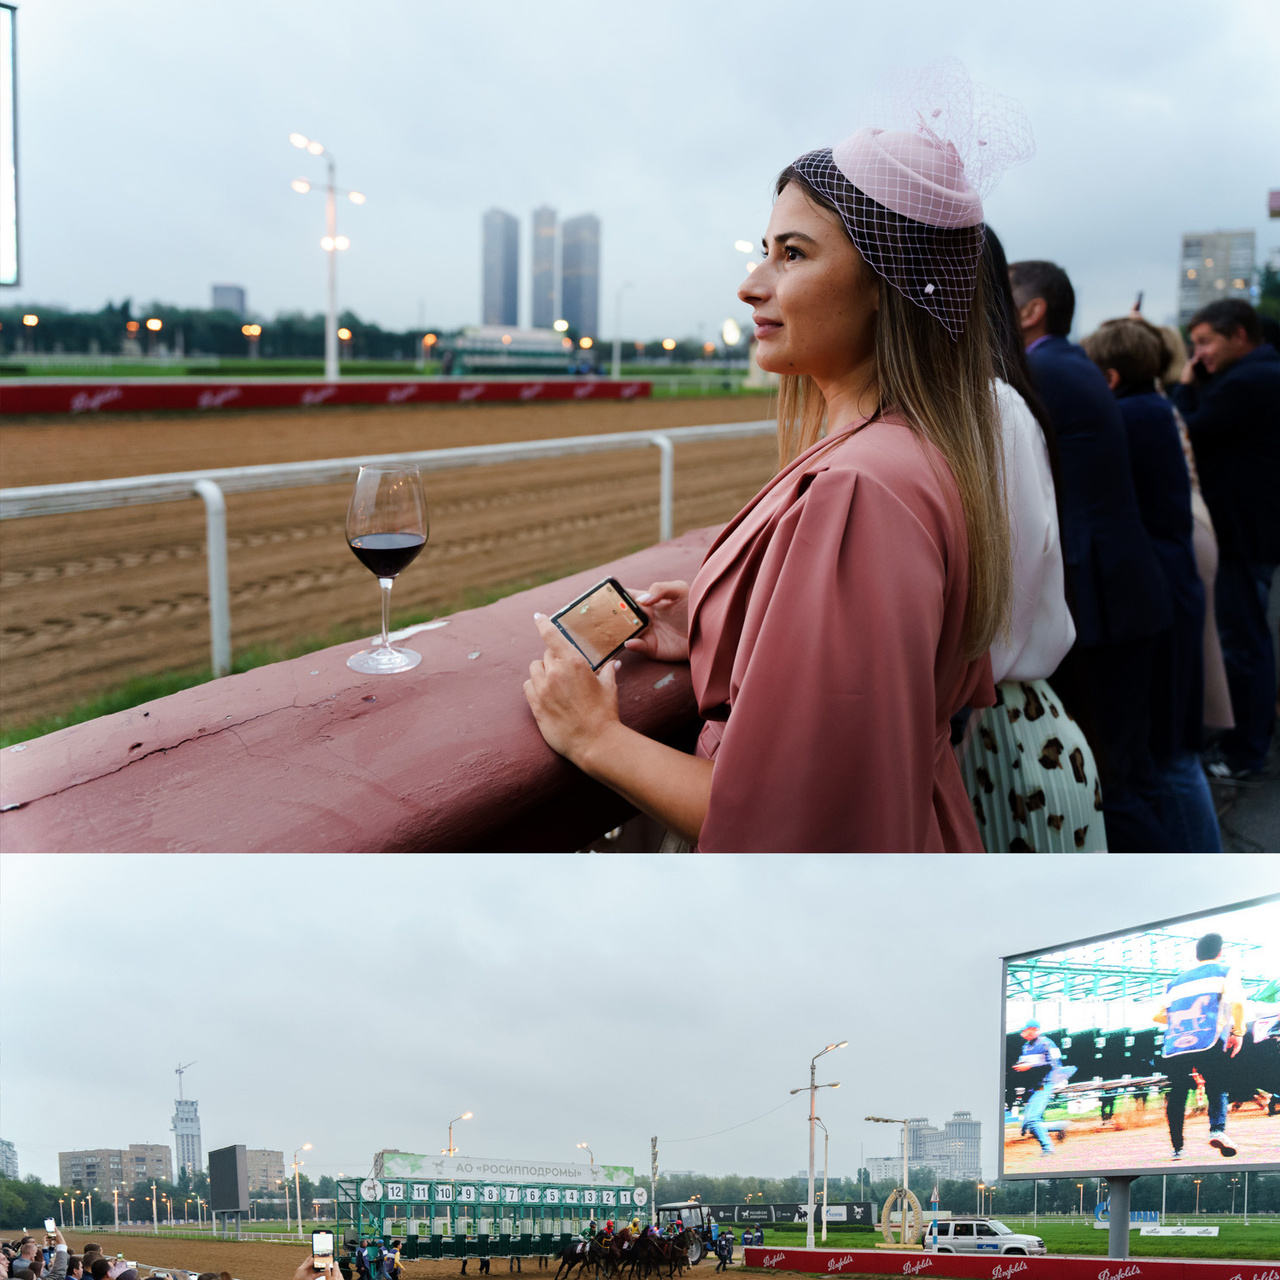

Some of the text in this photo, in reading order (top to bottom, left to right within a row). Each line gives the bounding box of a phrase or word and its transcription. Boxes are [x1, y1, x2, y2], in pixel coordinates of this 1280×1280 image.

[456, 1163, 473, 1173] АО
[389, 1186, 401, 1197] 12
[415, 1187, 426, 1198] 11
[440, 1188, 450, 1198] 10
[465, 1188, 471, 1199] 9
[488, 1189, 494, 1200] 8
[509, 1190, 515, 1200] 7
[530, 1190, 535, 1201] 6
[550, 1191, 555, 1201] 5
[569, 1192, 574, 1201] 4
[587, 1192, 593, 1202] 3
[605, 1193, 611, 1202] 2
[623, 1194, 627, 1202] 1
[763, 1252, 786, 1267] Penfolds
[827, 1254, 853, 1272] Penfolds
[902, 1258, 933, 1275] Penfolds
[992, 1260, 1028, 1280] Penfolds
